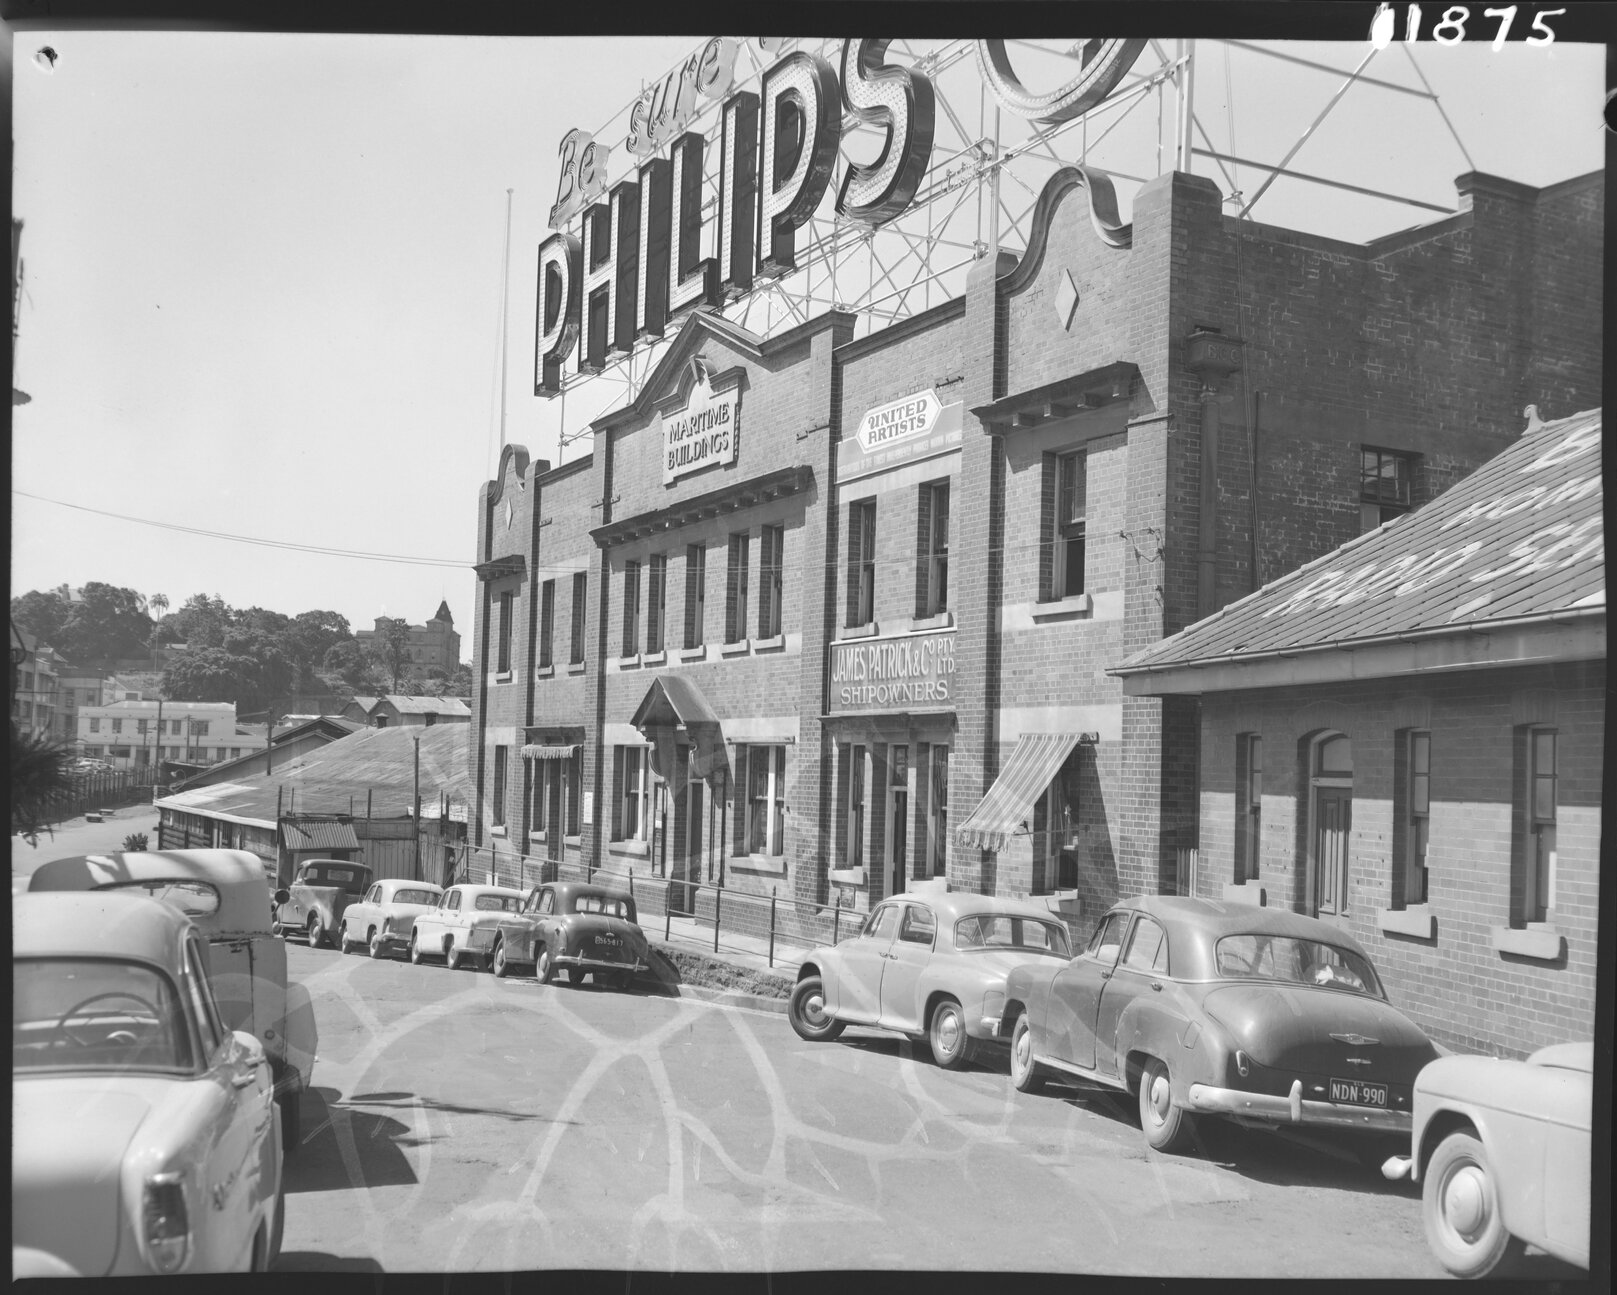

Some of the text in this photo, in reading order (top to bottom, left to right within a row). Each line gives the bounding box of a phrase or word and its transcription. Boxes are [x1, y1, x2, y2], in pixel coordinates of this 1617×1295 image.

[549, 36, 741, 228] Be sure
[534, 37, 935, 397] PHILIPS
[669, 403, 731, 445] MARITIME
[868, 400, 928, 428] UNITED
[868, 414, 927, 444] ARTISTS
[667, 431, 731, 471] BUILDINGS
[834, 646, 867, 682] JAMES
[868, 641, 913, 678] PATRICK
